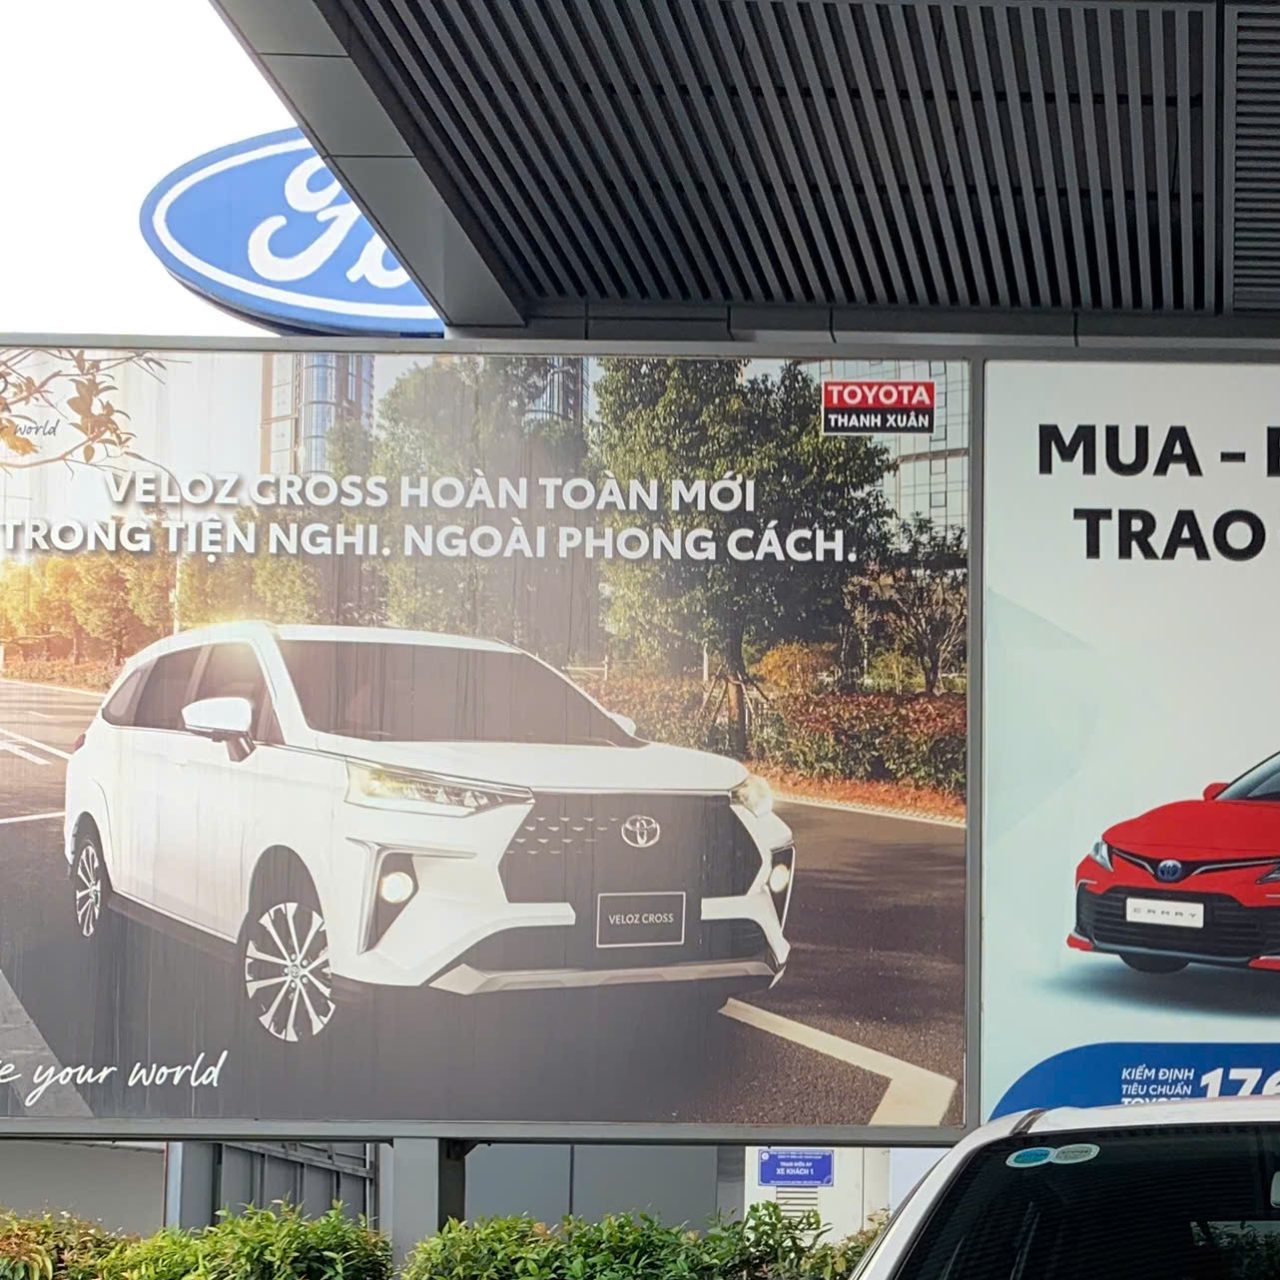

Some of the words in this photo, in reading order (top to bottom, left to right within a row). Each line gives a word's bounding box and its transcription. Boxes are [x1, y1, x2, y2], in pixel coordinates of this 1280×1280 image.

[828, 385, 930, 405] TOYOTA
[828, 414, 881, 428] THANH
[886, 411, 929, 428] XUÂN
[1039, 424, 1203, 477] MUA
[104, 471, 239, 505] VELOZ
[250, 474, 388, 507] CROSS
[401, 469, 527, 508] HOÀN
[539, 469, 658, 511] TOÀN
[671, 470, 755, 511] MỚI
[1, 518, 151, 551] TRONG
[159, 513, 256, 563] TIỆN
[269, 522, 391, 556] NGHI.
[404, 516, 545, 558] NGOÀI
[559, 526, 717, 561] PHONG
[727, 519, 858, 562] CÁCH.
[1073, 508, 1267, 562] TRAO
[608, 914, 640, 925] VELOZ
[641, 912, 674, 924] CROSS
[25, 1061, 118, 1107] your
[128, 1050, 228, 1087] world
[1121, 1063, 1155, 1080] KIỂM
[1158, 1067, 1195, 1083] ĐỊNH
[1121, 1082, 1147, 1095] TIÊU
[1148, 1081, 1192, 1095] CHUẨN
